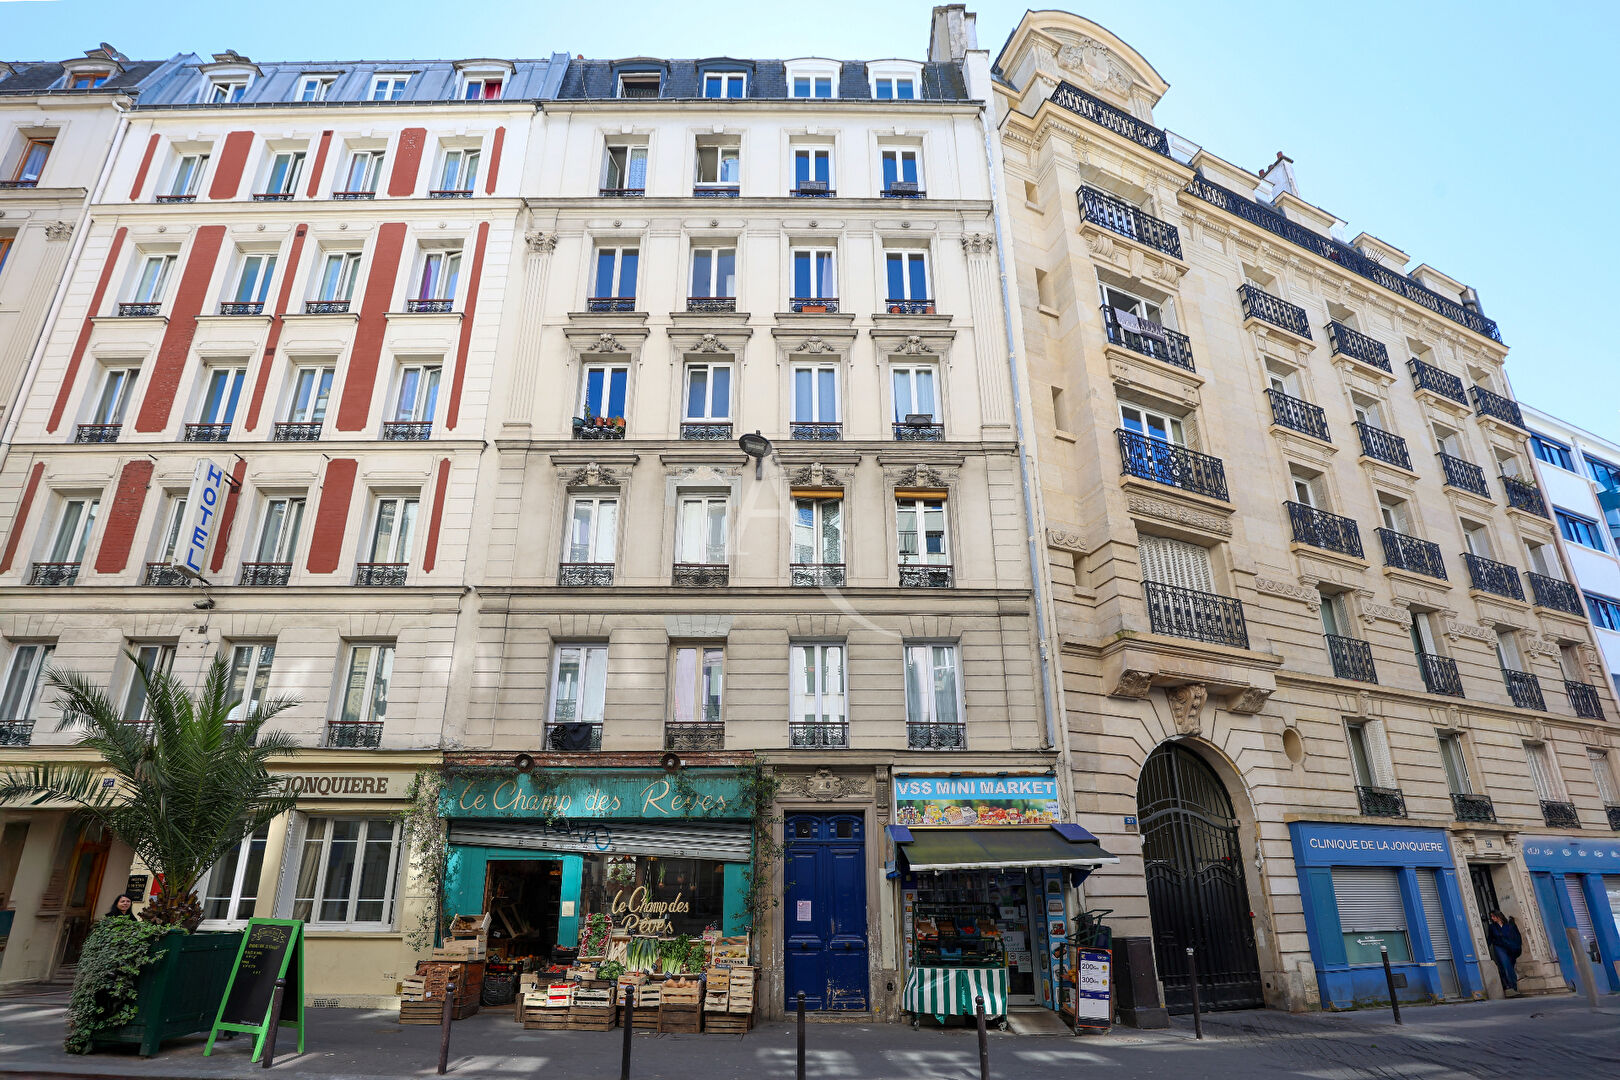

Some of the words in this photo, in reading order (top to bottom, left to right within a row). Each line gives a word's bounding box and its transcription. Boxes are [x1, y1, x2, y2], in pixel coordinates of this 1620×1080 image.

[187, 464, 222, 572] HOTEL
[280, 775, 388, 795] JONQUIERE
[493, 780, 572, 812] Champ
[585, 788, 621, 811] des
[897, 782, 933, 795] VSS
[936, 782, 976, 794] MINI
[979, 781, 1055, 794] MARKET
[1309, 838, 1359, 850] CLINIQUE
[1361, 841, 1375, 850] DE
[1376, 841, 1389, 851] LA
[1390, 841, 1444, 852] JONQUIERE
[629, 886, 668, 918] Champ
[668, 892, 689, 913] des
